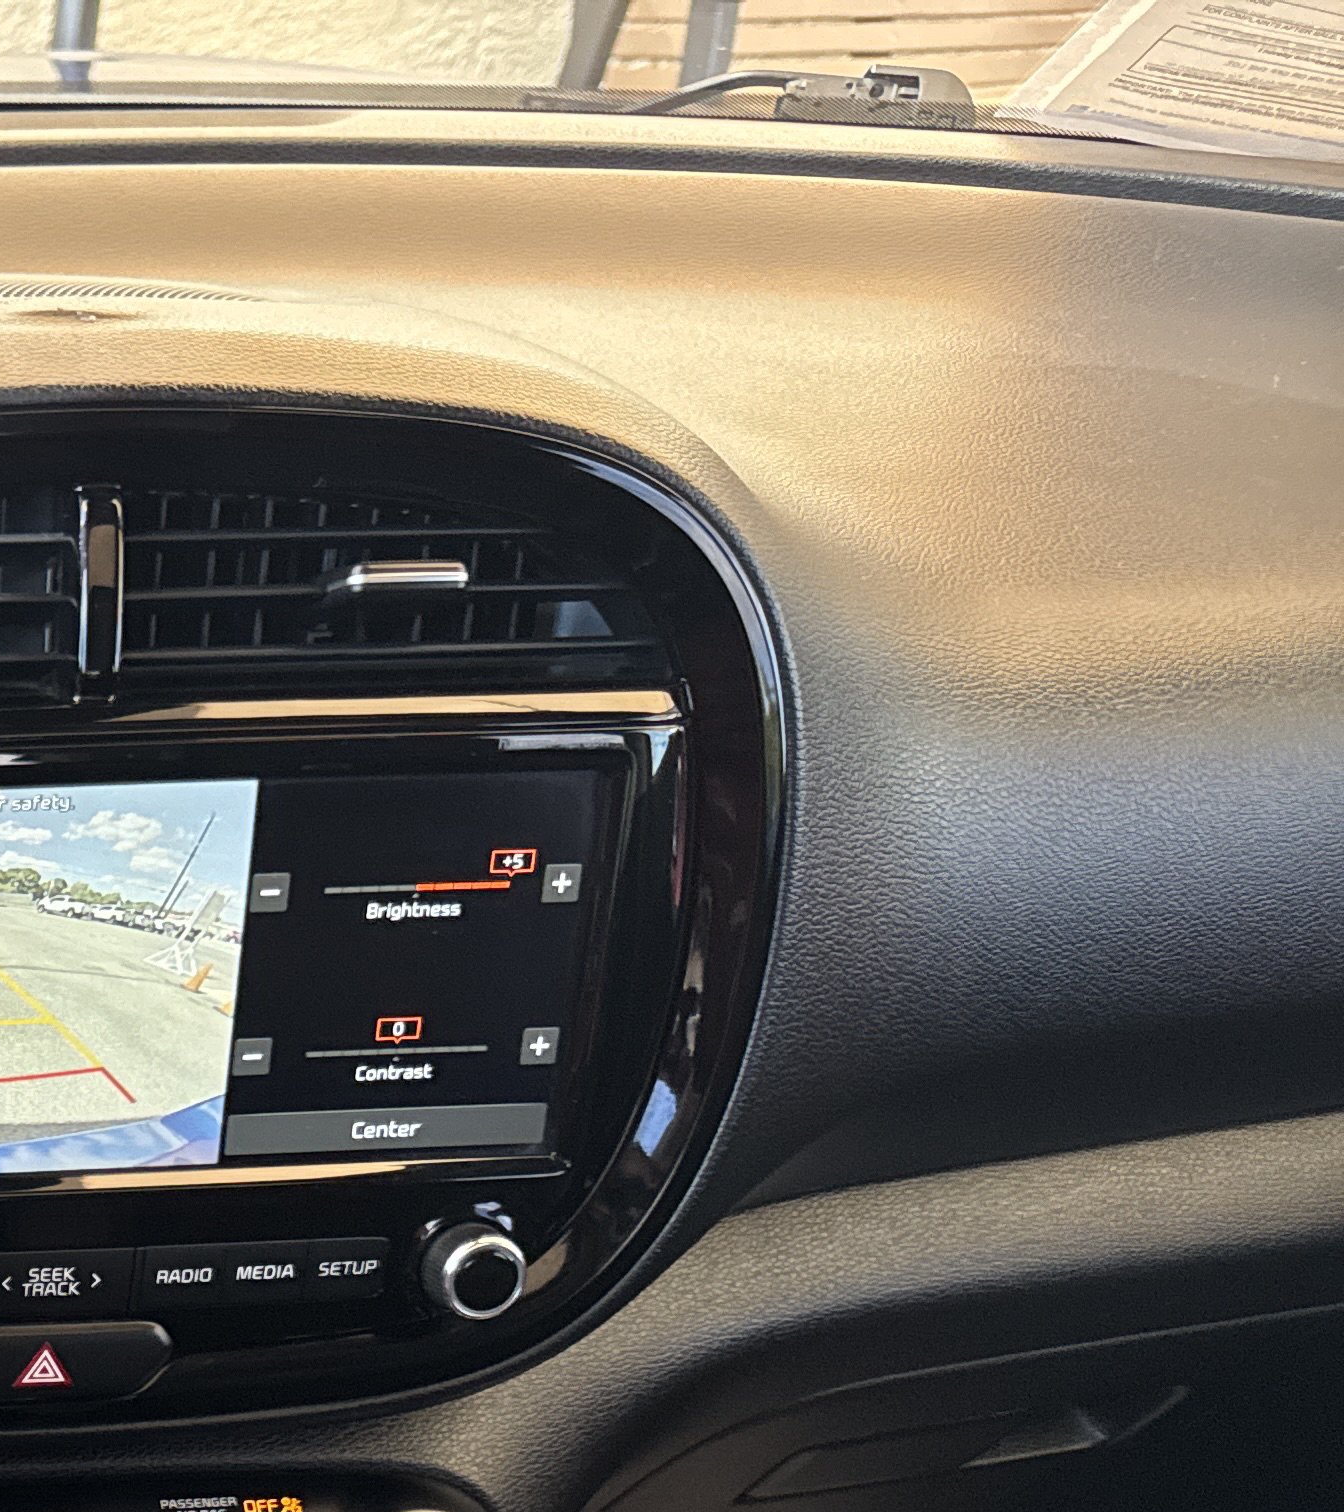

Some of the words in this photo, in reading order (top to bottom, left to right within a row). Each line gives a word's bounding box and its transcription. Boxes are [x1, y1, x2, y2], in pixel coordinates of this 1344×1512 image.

[12, 795, 75, 812] safety.
[366, 901, 462, 921] Brightness
[393, 1021, 405, 1036] 0
[354, 1064, 433, 1082] Contrast
[351, 1120, 422, 1139] Center
[28, 1266, 75, 1282] SEEK
[156, 1267, 212, 1285] RADIO
[235, 1264, 295, 1281] MEDIA
[317, 1259, 378, 1276] SETUP
[22, 1280, 81, 1297] TRACK
[160, 1496, 238, 1511] PASSENGER
